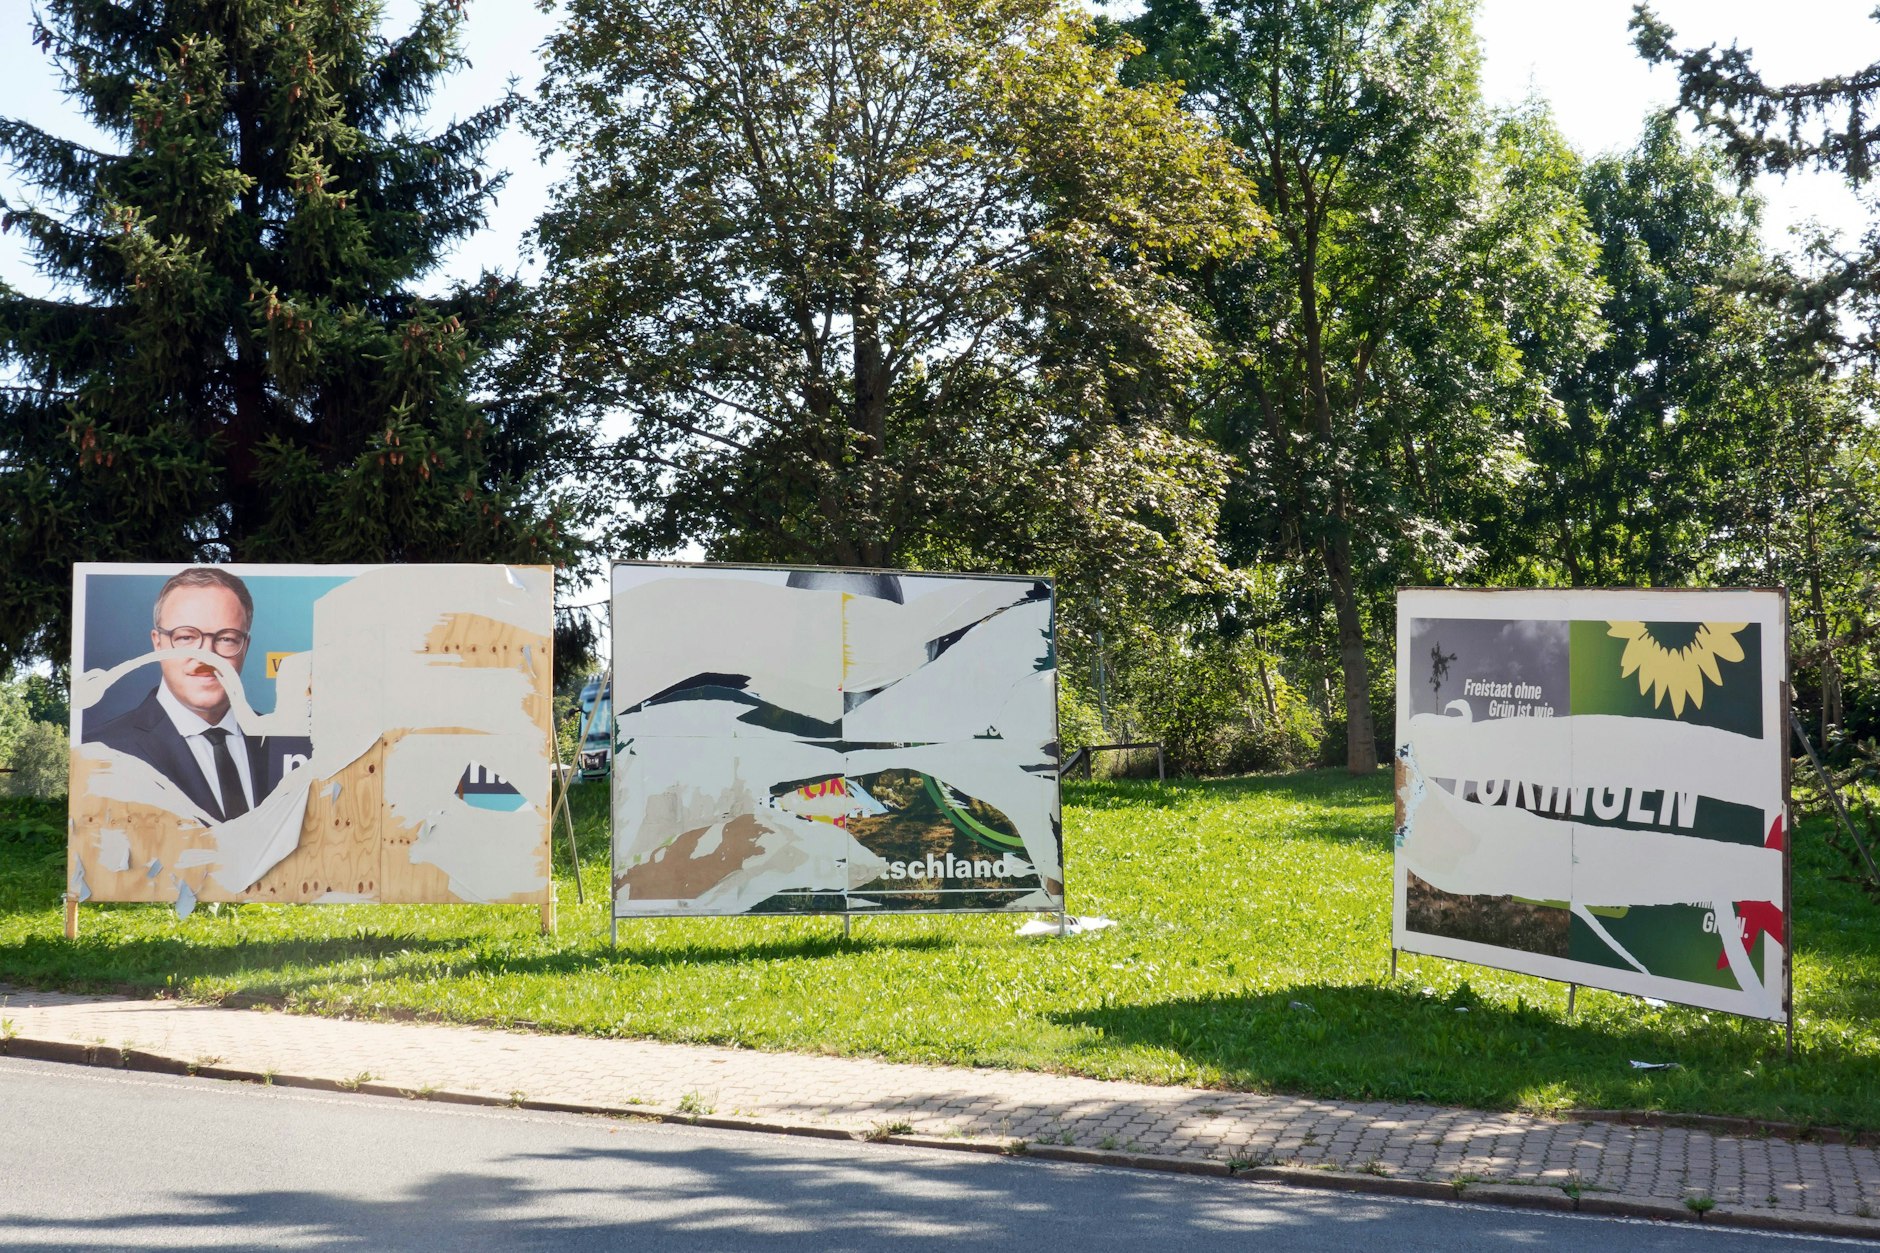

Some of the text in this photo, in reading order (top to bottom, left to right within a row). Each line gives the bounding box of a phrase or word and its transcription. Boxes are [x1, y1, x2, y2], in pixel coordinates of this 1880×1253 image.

[1464, 678, 1542, 700] Freistaat ohne
[1489, 699, 1554, 718] Grün ist wie
